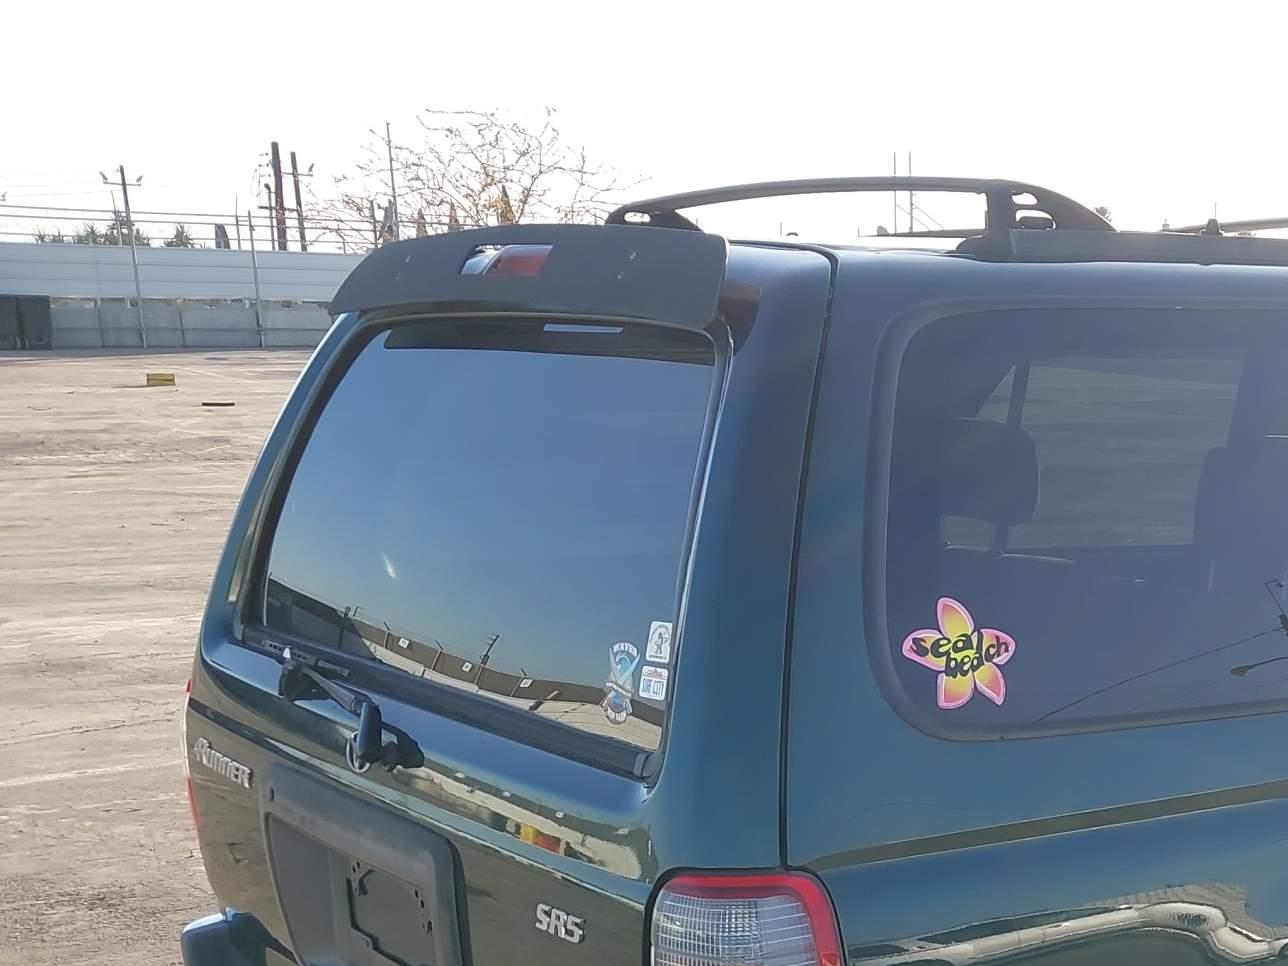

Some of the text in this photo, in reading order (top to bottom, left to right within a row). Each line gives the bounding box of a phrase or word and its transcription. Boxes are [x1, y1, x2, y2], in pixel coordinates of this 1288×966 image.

[910, 630, 984, 658] seal
[945, 635, 1010, 679] beach
[535, 903, 585, 944] SR5
